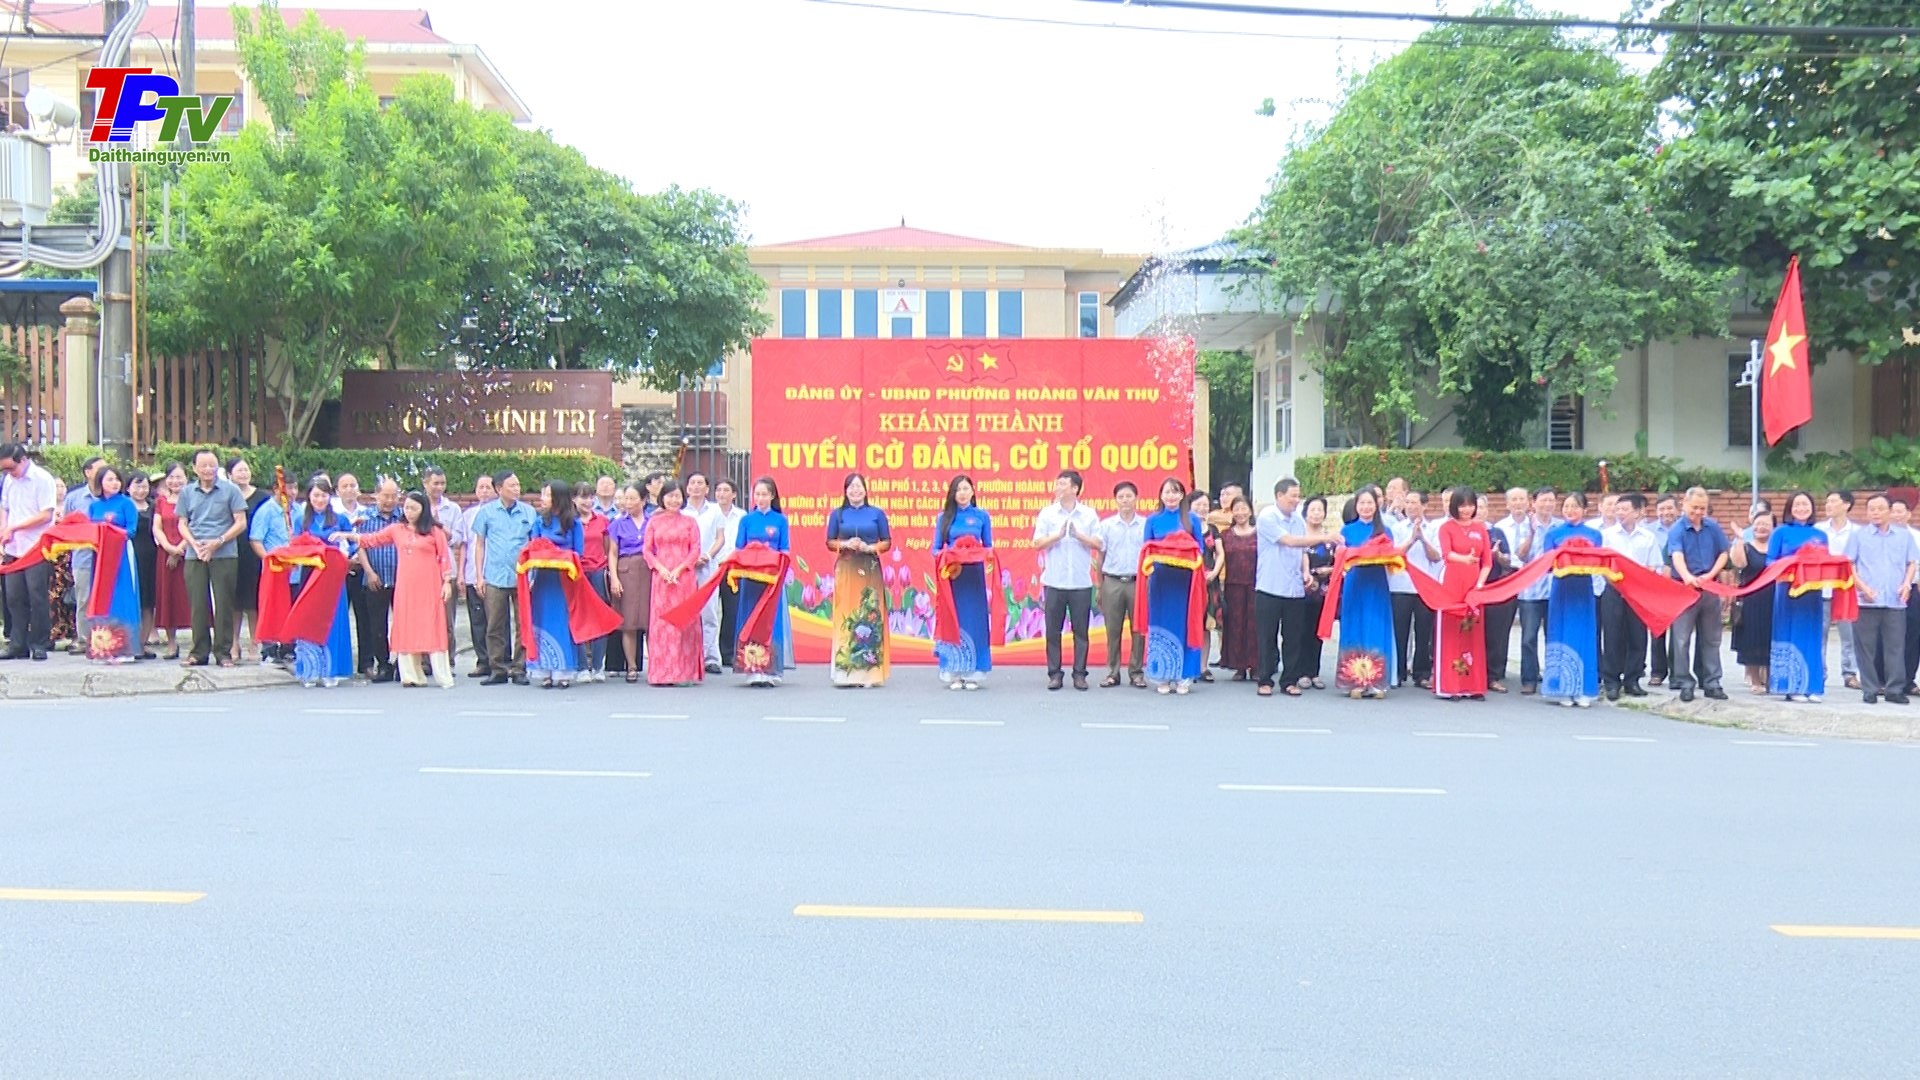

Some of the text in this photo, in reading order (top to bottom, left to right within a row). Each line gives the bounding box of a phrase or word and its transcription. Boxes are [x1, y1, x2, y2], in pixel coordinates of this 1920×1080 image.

[785, 383, 835, 400] ĐẢNG
[881, 386, 931, 400] UBND
[936, 384, 1010, 400] PHƯỜNG
[1016, 384, 1078, 400] HOÀNG
[1083, 385, 1120, 400] VĂN
[1125, 388, 1160, 403] THỤ
[553, 408, 597, 438] TRỊ
[879, 407, 1064, 432] KHÁNH THÀNH
[766, 434, 1178, 473] TUYẾN CỜ ĐẢNG, CỜ TỔ QUỐC
[870, 478, 890, 492] DÂN
[891, 476, 910, 492] PHỐ
[977, 478, 1014, 492] PHƯỜNG
[1015, 478, 1046, 492] HOÀNG
[787, 511, 800, 526] VÀ
[801, 511, 825, 528] QUỐC
[910, 511, 928, 528] HÒA
